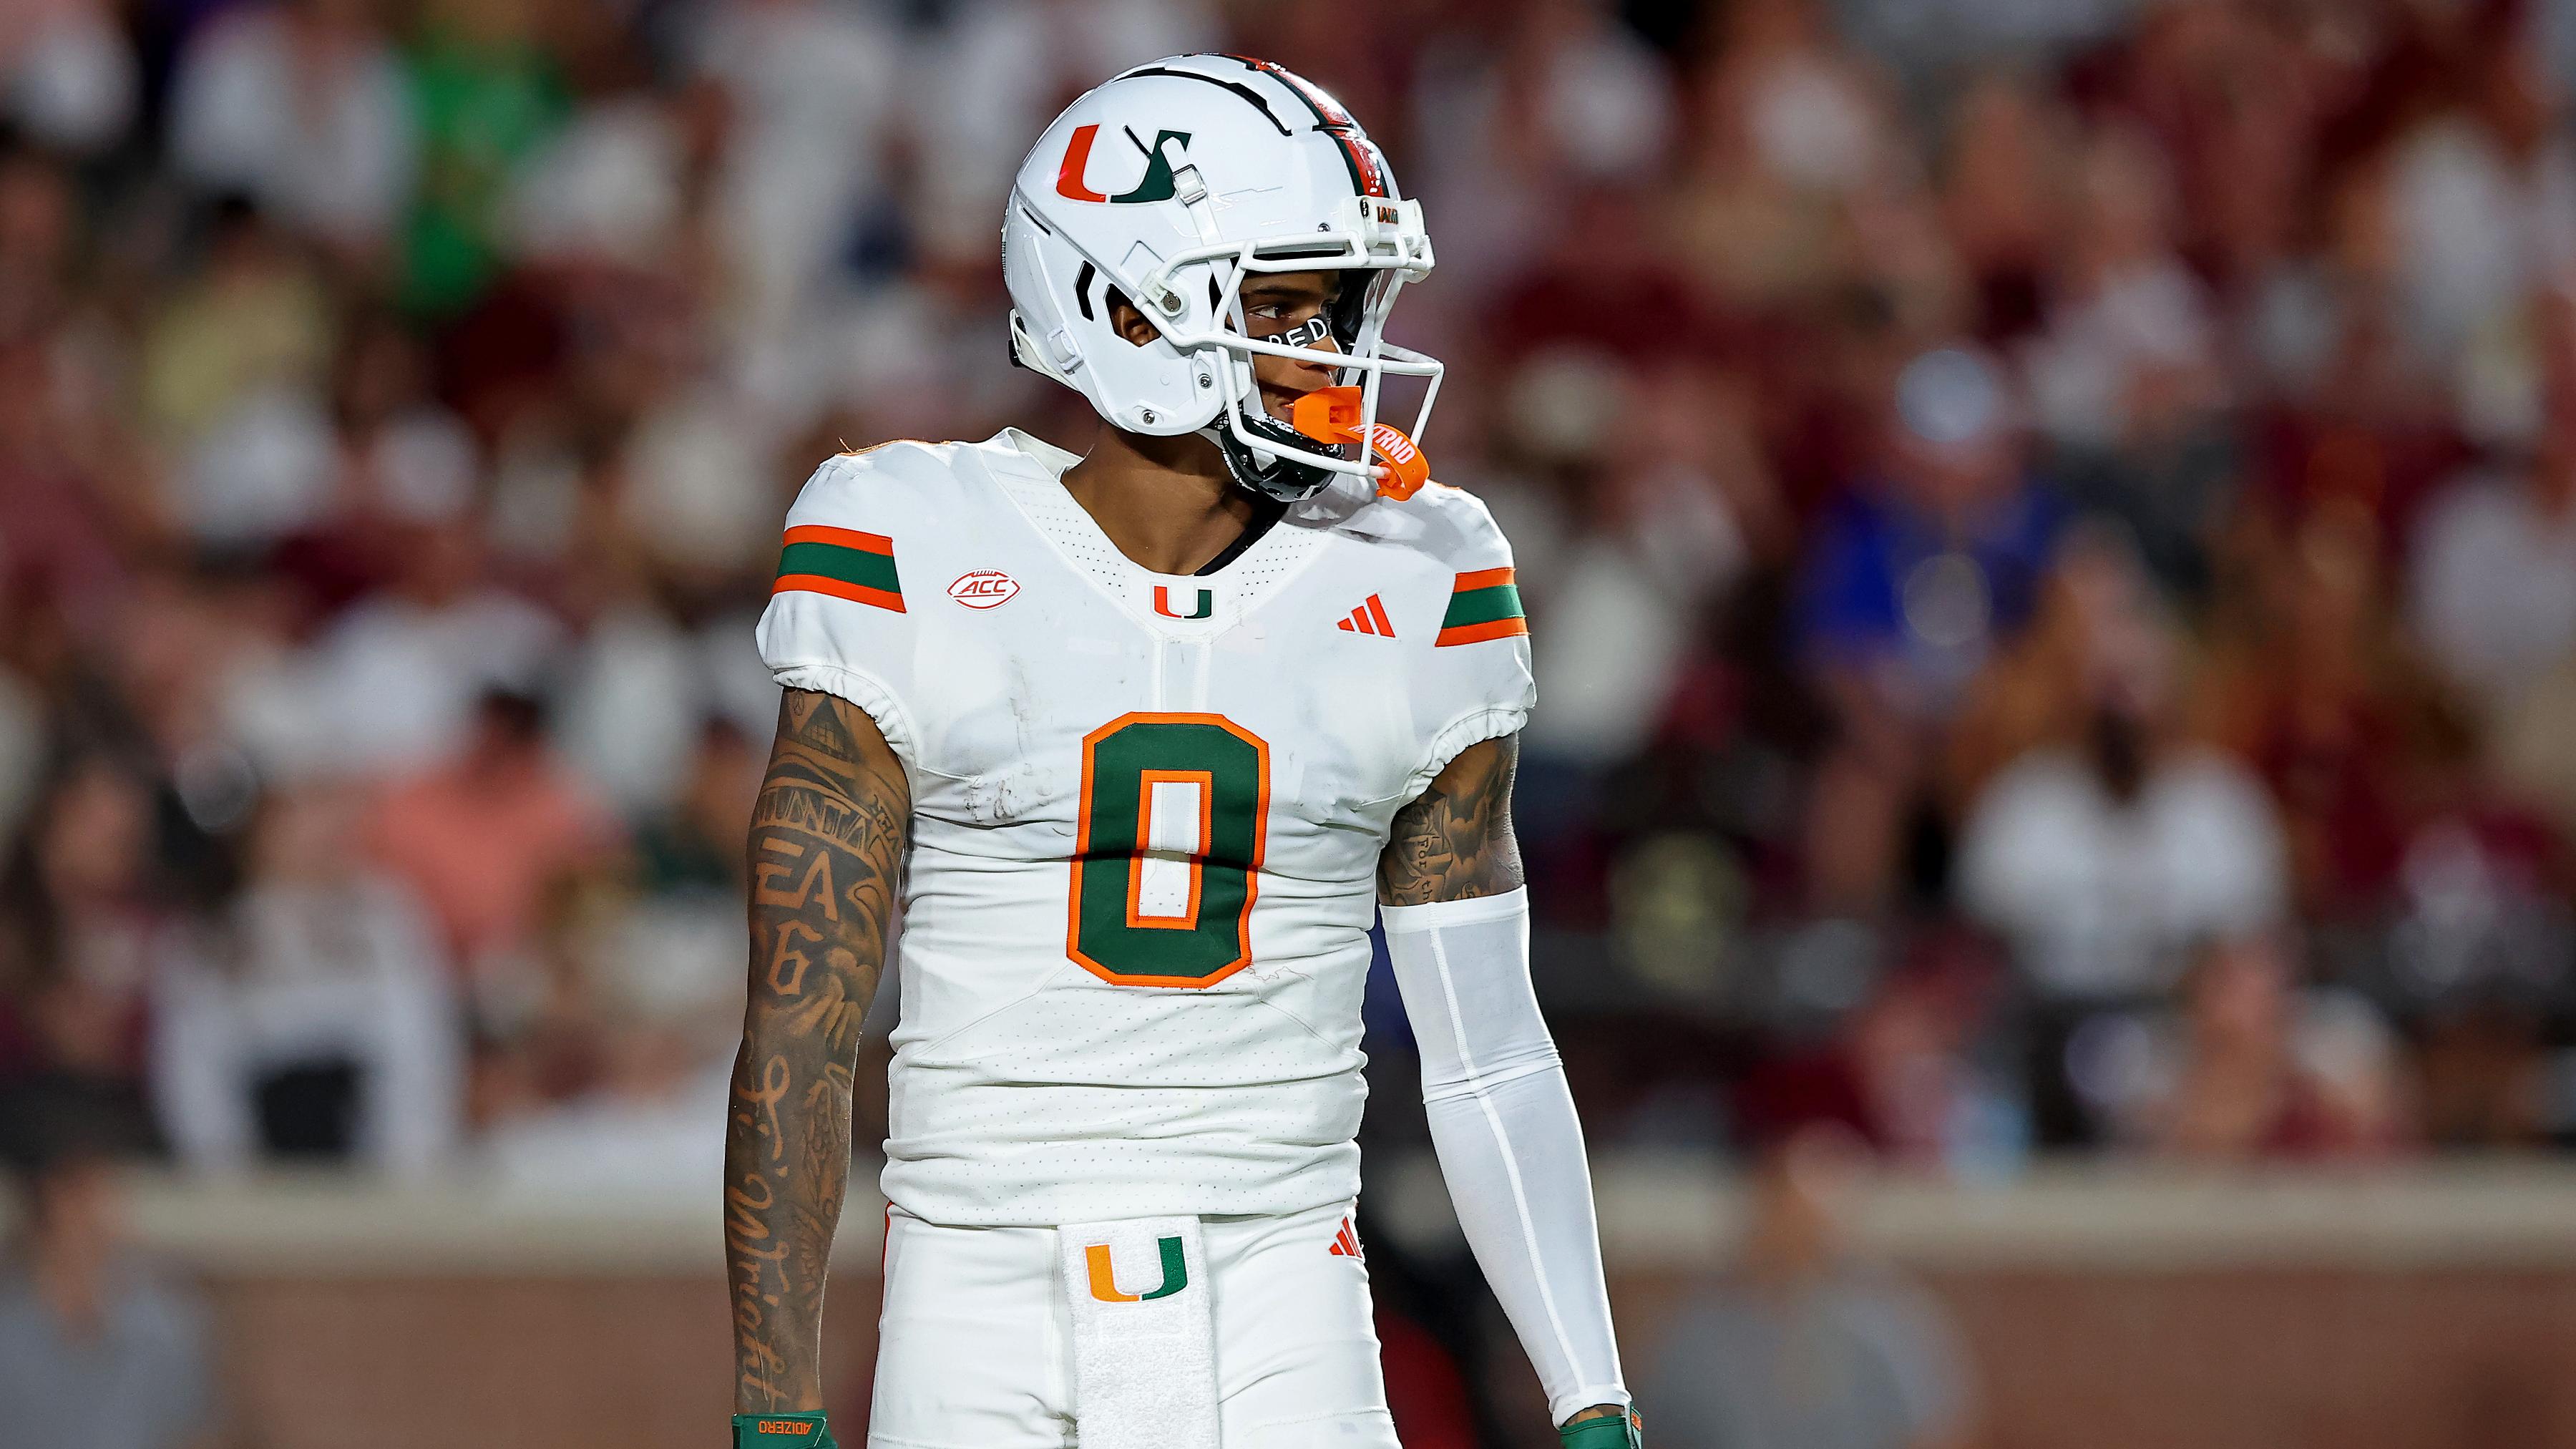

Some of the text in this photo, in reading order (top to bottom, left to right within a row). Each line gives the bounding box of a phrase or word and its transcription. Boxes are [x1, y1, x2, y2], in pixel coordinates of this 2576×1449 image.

[1055, 123, 1193, 204] U
[1347, 424, 1416, 465] NTRND
[959, 580, 1008, 595] ACC
[1153, 585, 1213, 620] U
[754, 836, 839, 923] EA
[1066, 711, 1271, 989] 0
[767, 919, 824, 996] 6
[1084, 1235, 1189, 1303] U
[758, 1420, 814, 1436] ADIZERO
